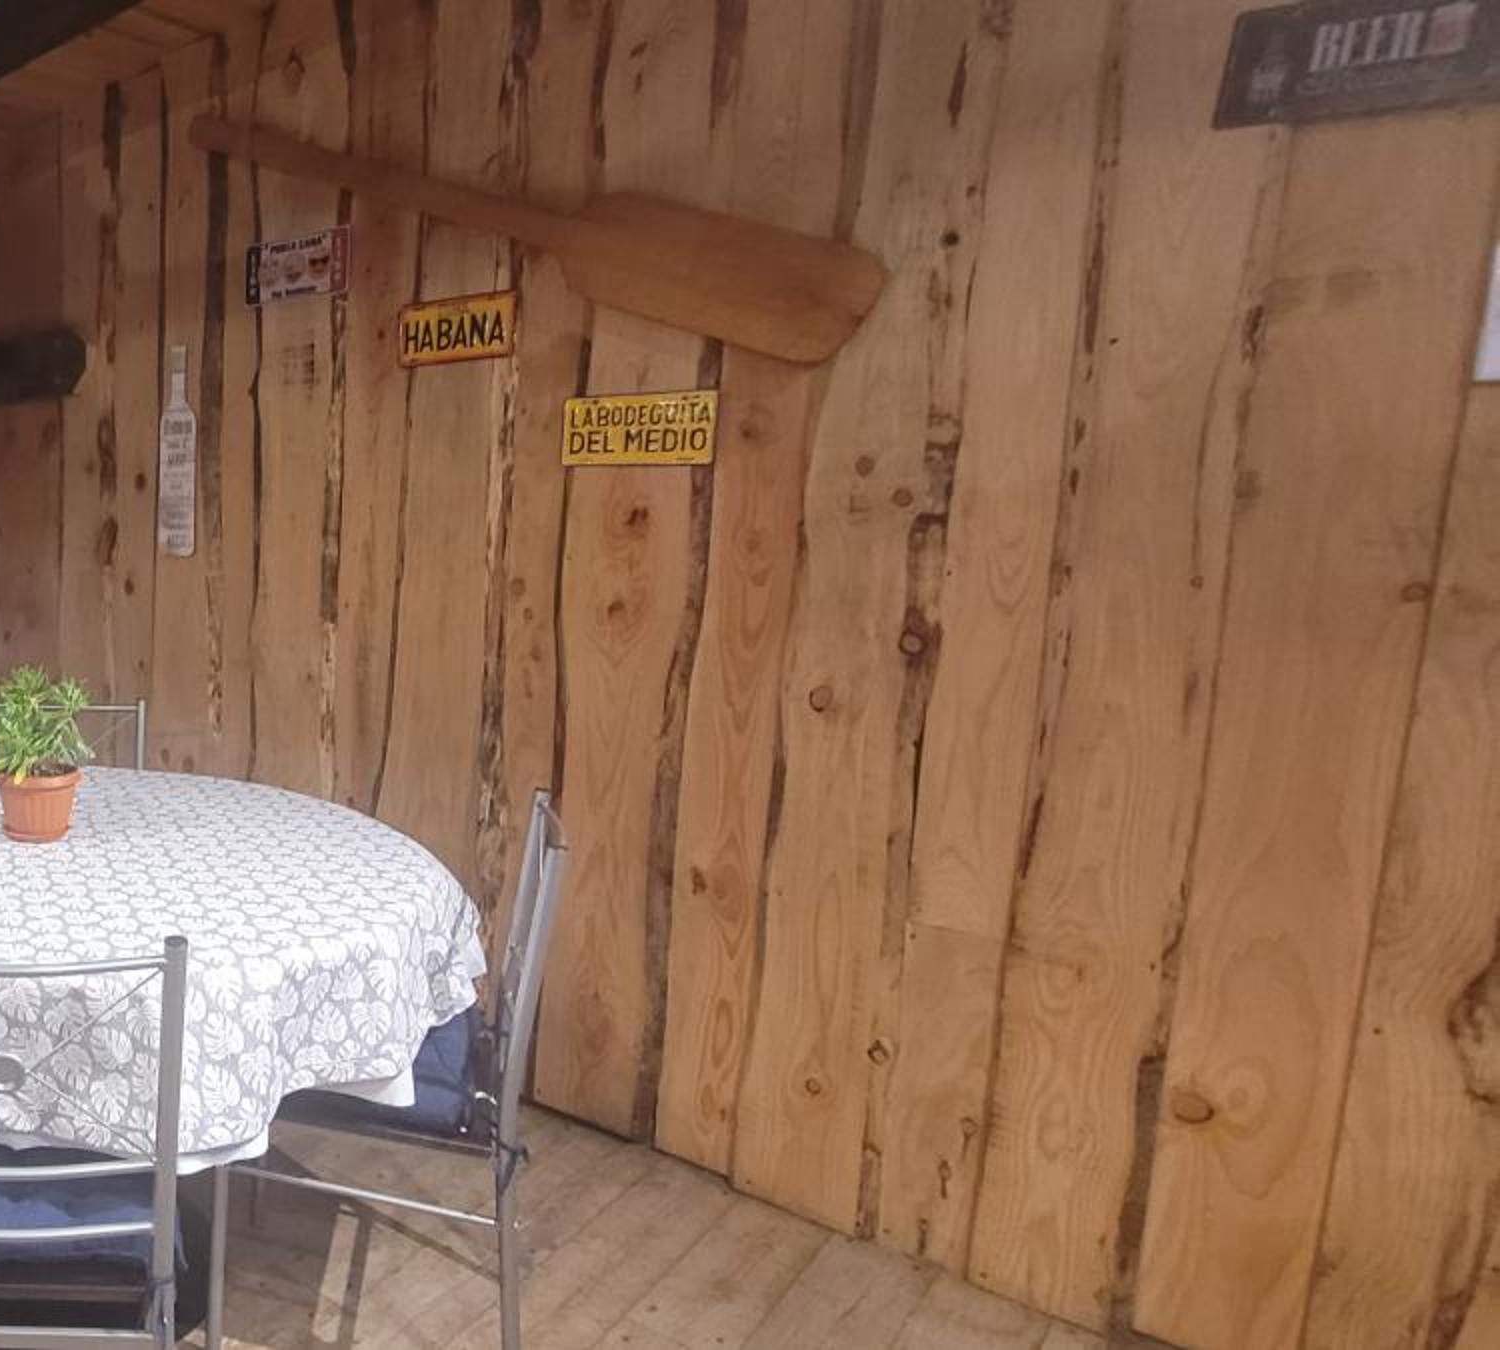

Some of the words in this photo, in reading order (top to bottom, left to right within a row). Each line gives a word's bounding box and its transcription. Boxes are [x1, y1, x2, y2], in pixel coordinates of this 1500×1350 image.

[1308, 9, 1428, 74] BEER
[403, 310, 504, 355] HABANA
[569, 431, 614, 454] DEL
[623, 428, 707, 453] MEDIO
